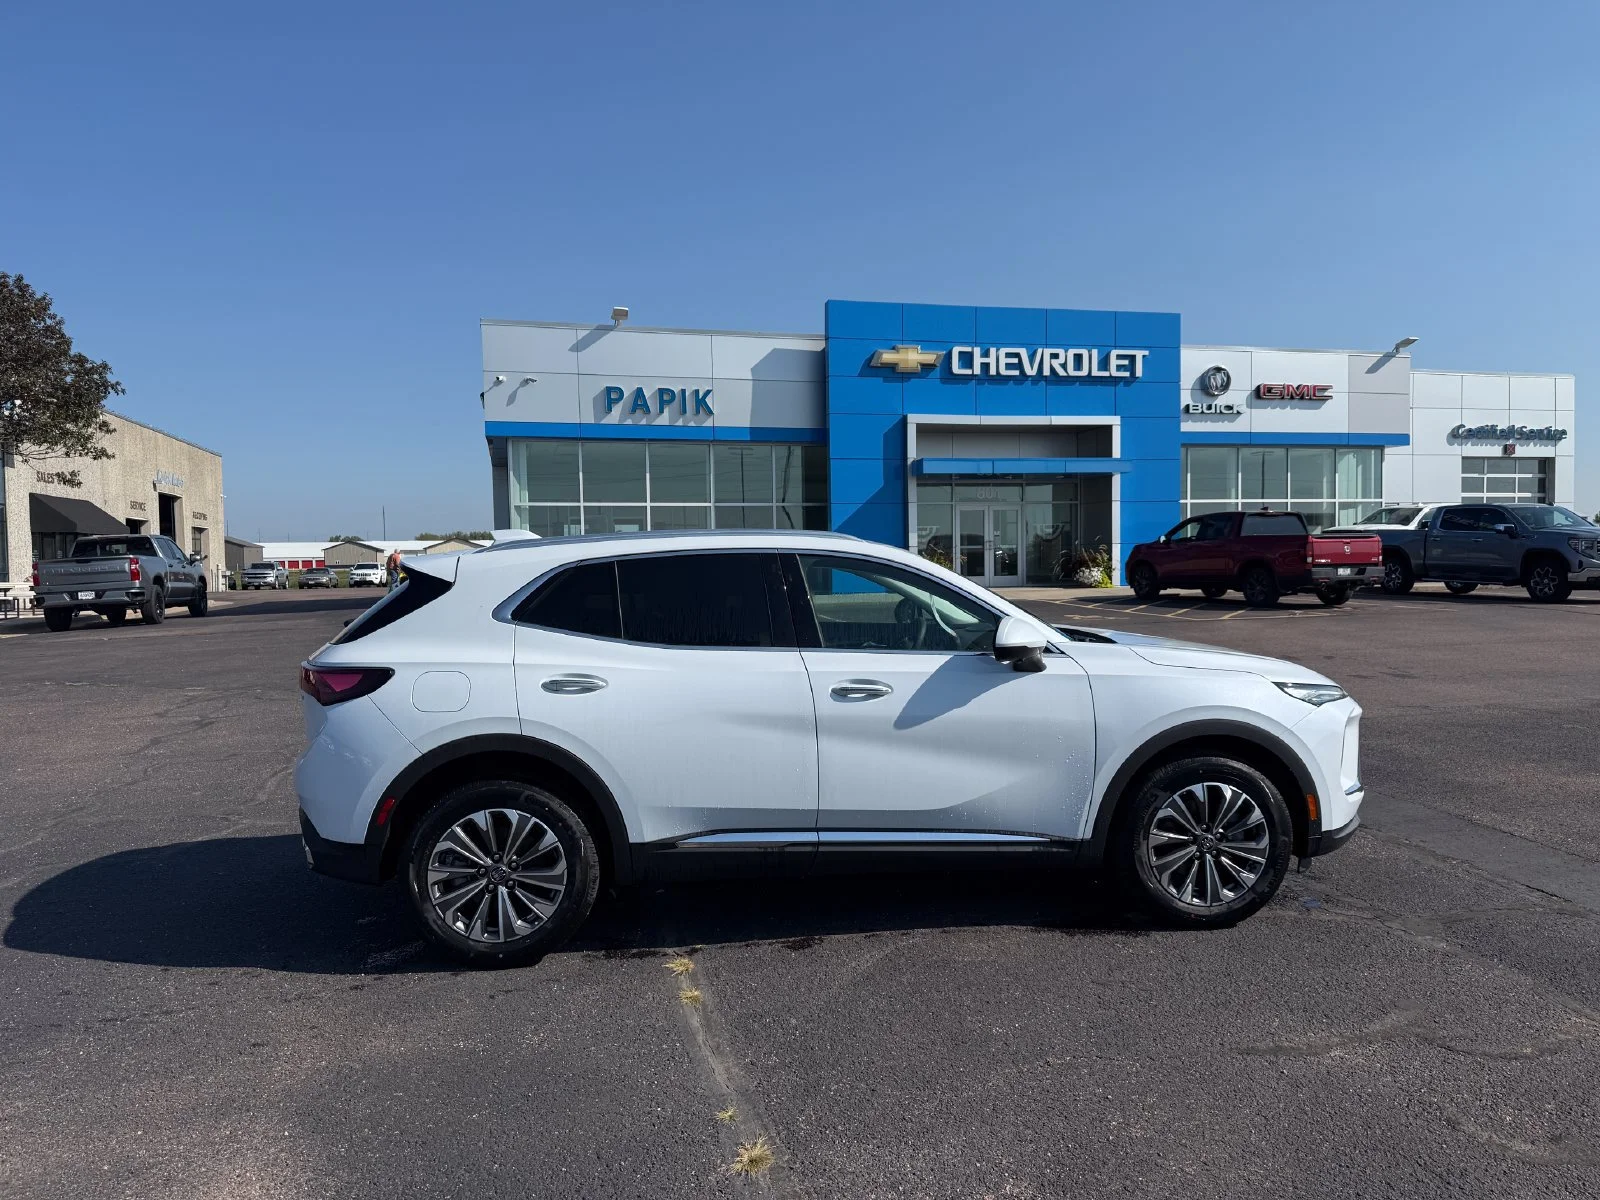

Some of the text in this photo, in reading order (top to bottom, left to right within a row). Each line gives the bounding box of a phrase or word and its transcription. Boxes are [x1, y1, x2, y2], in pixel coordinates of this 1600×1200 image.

[952, 346, 1149, 377] CHEVROLET
[1259, 383, 1333, 400] GMC
[605, 386, 714, 415] PAPIK
[1187, 403, 1246, 414] BUICK
[1451, 424, 1567, 440] Certified Service
